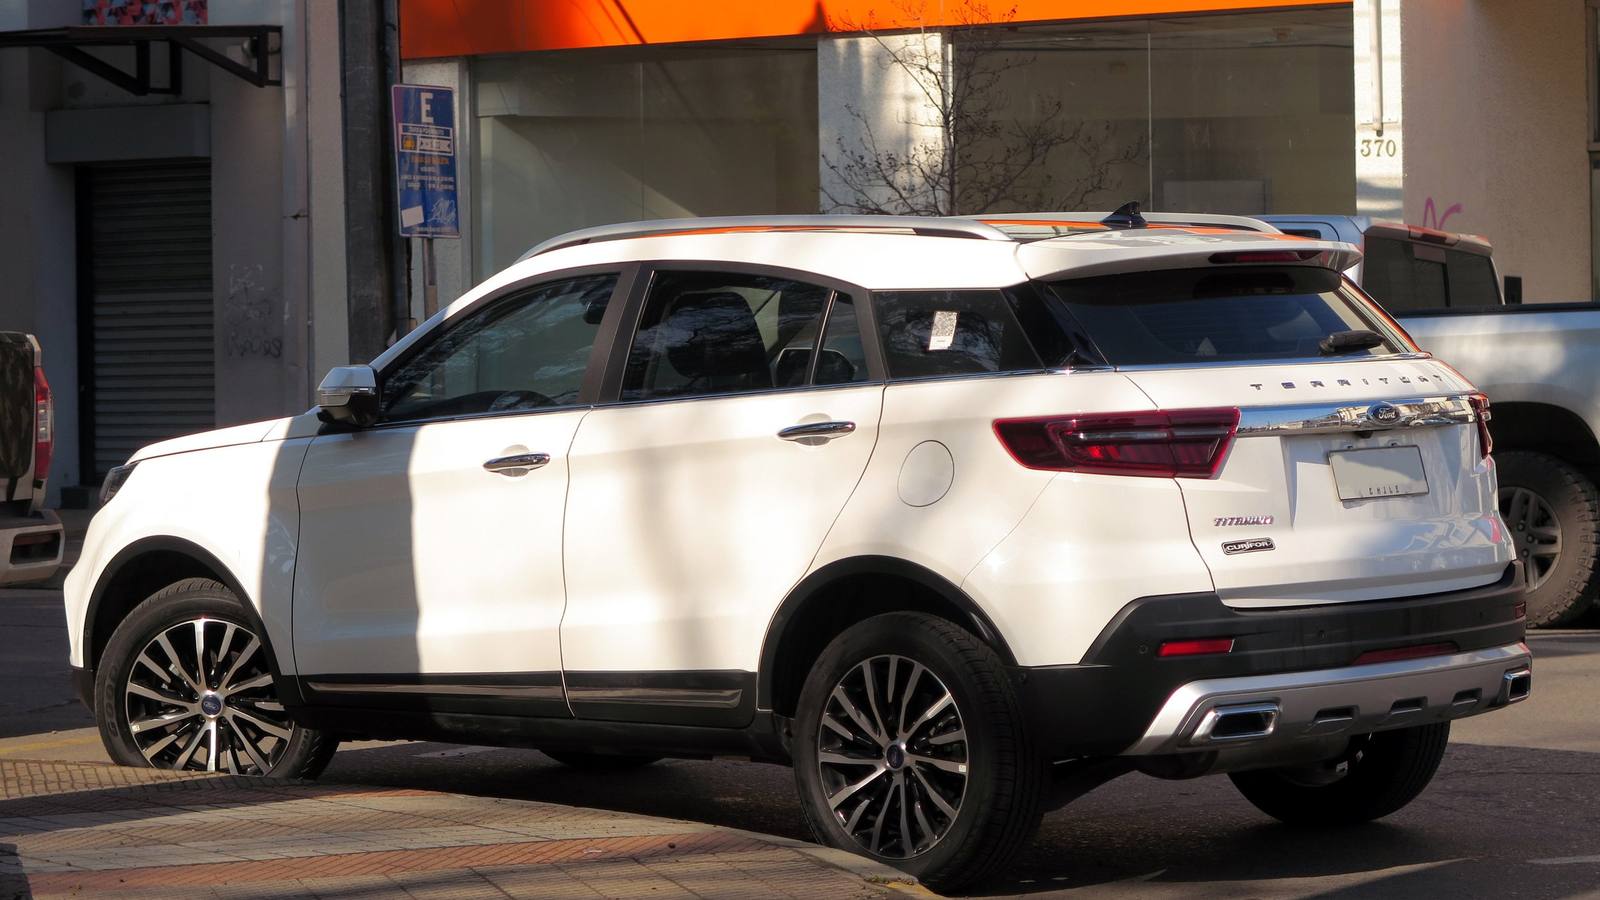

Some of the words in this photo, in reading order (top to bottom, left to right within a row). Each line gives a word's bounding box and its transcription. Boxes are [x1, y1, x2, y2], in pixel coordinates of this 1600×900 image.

[421, 92, 434, 124] E
[1360, 139, 1396, 157] 370
[1379, 407, 1396, 419] Ford
[1368, 485, 1400, 495] CHILE
